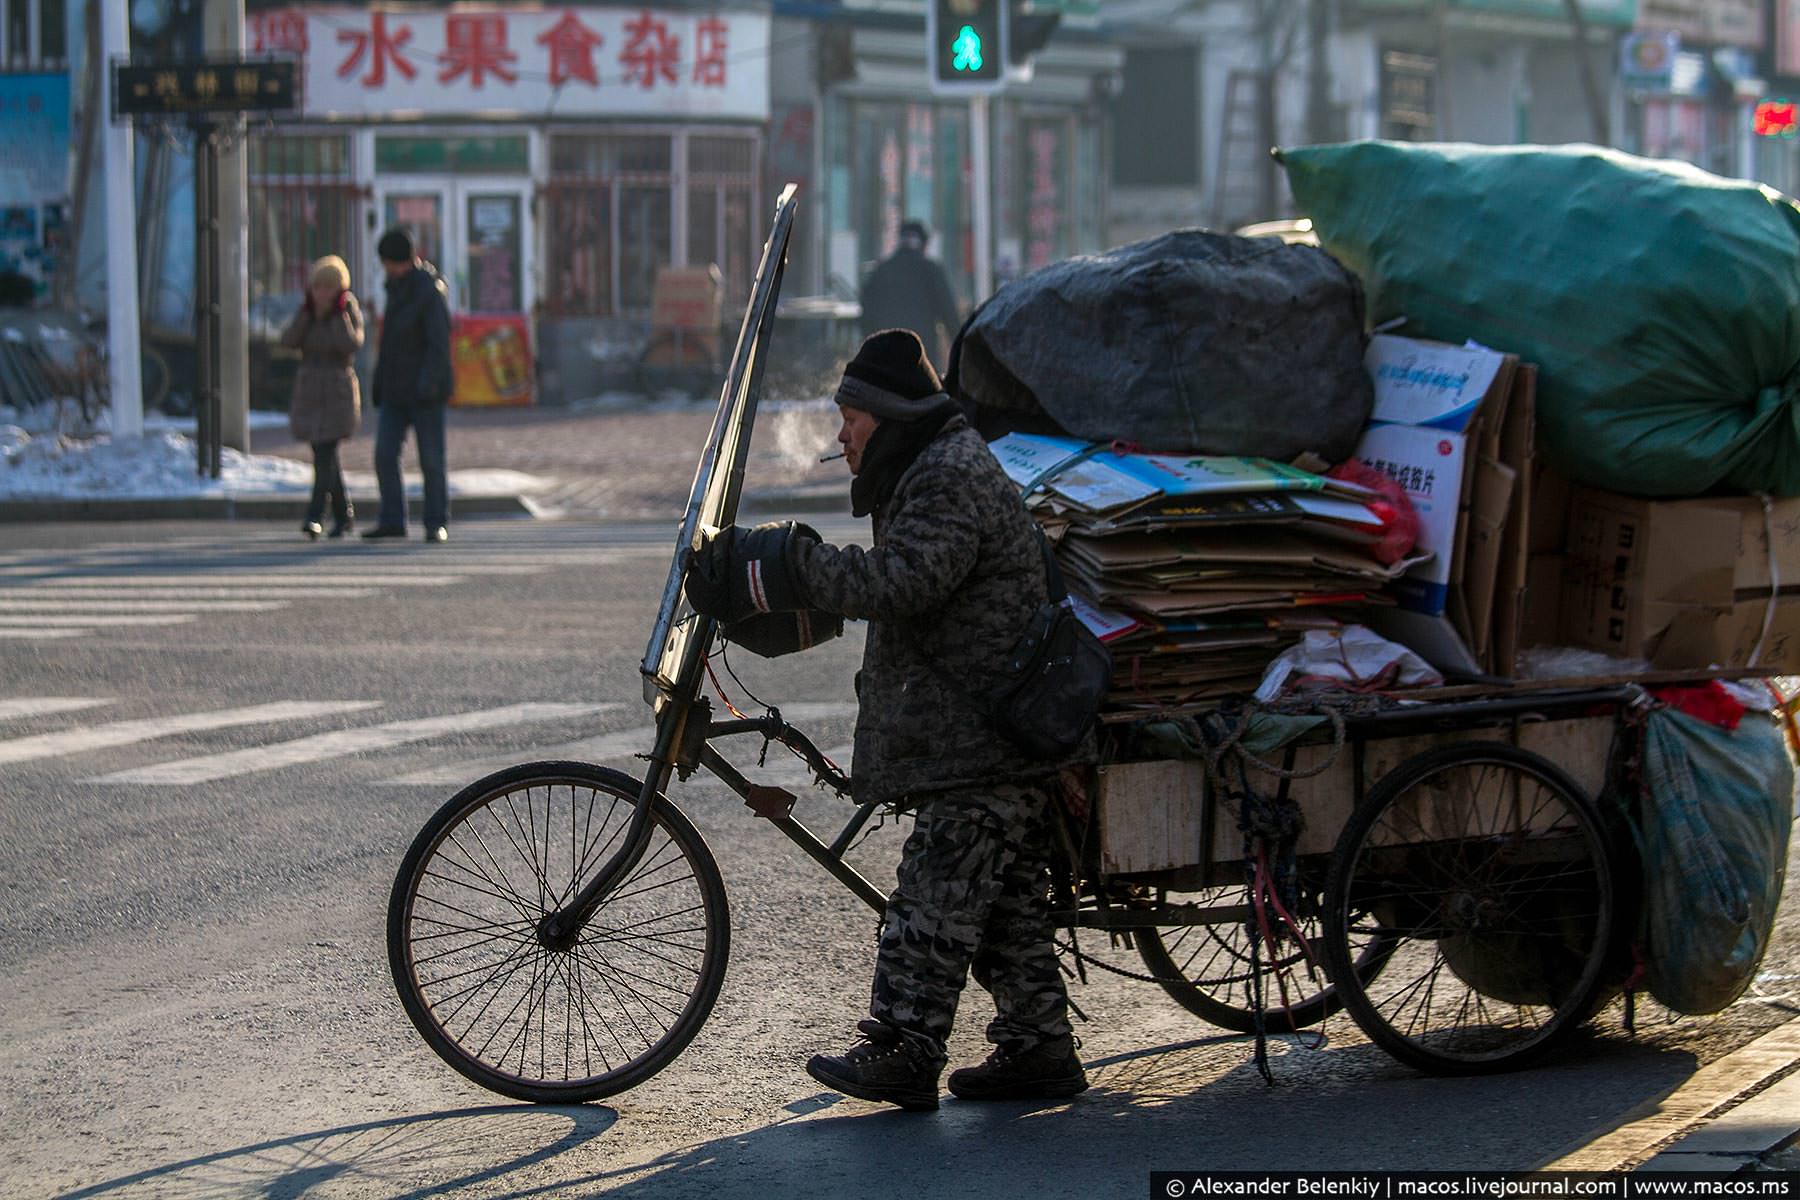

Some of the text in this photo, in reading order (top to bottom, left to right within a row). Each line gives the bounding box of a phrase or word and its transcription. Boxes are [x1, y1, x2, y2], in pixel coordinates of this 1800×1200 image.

[337, 10, 731, 89] 水果食杂店
